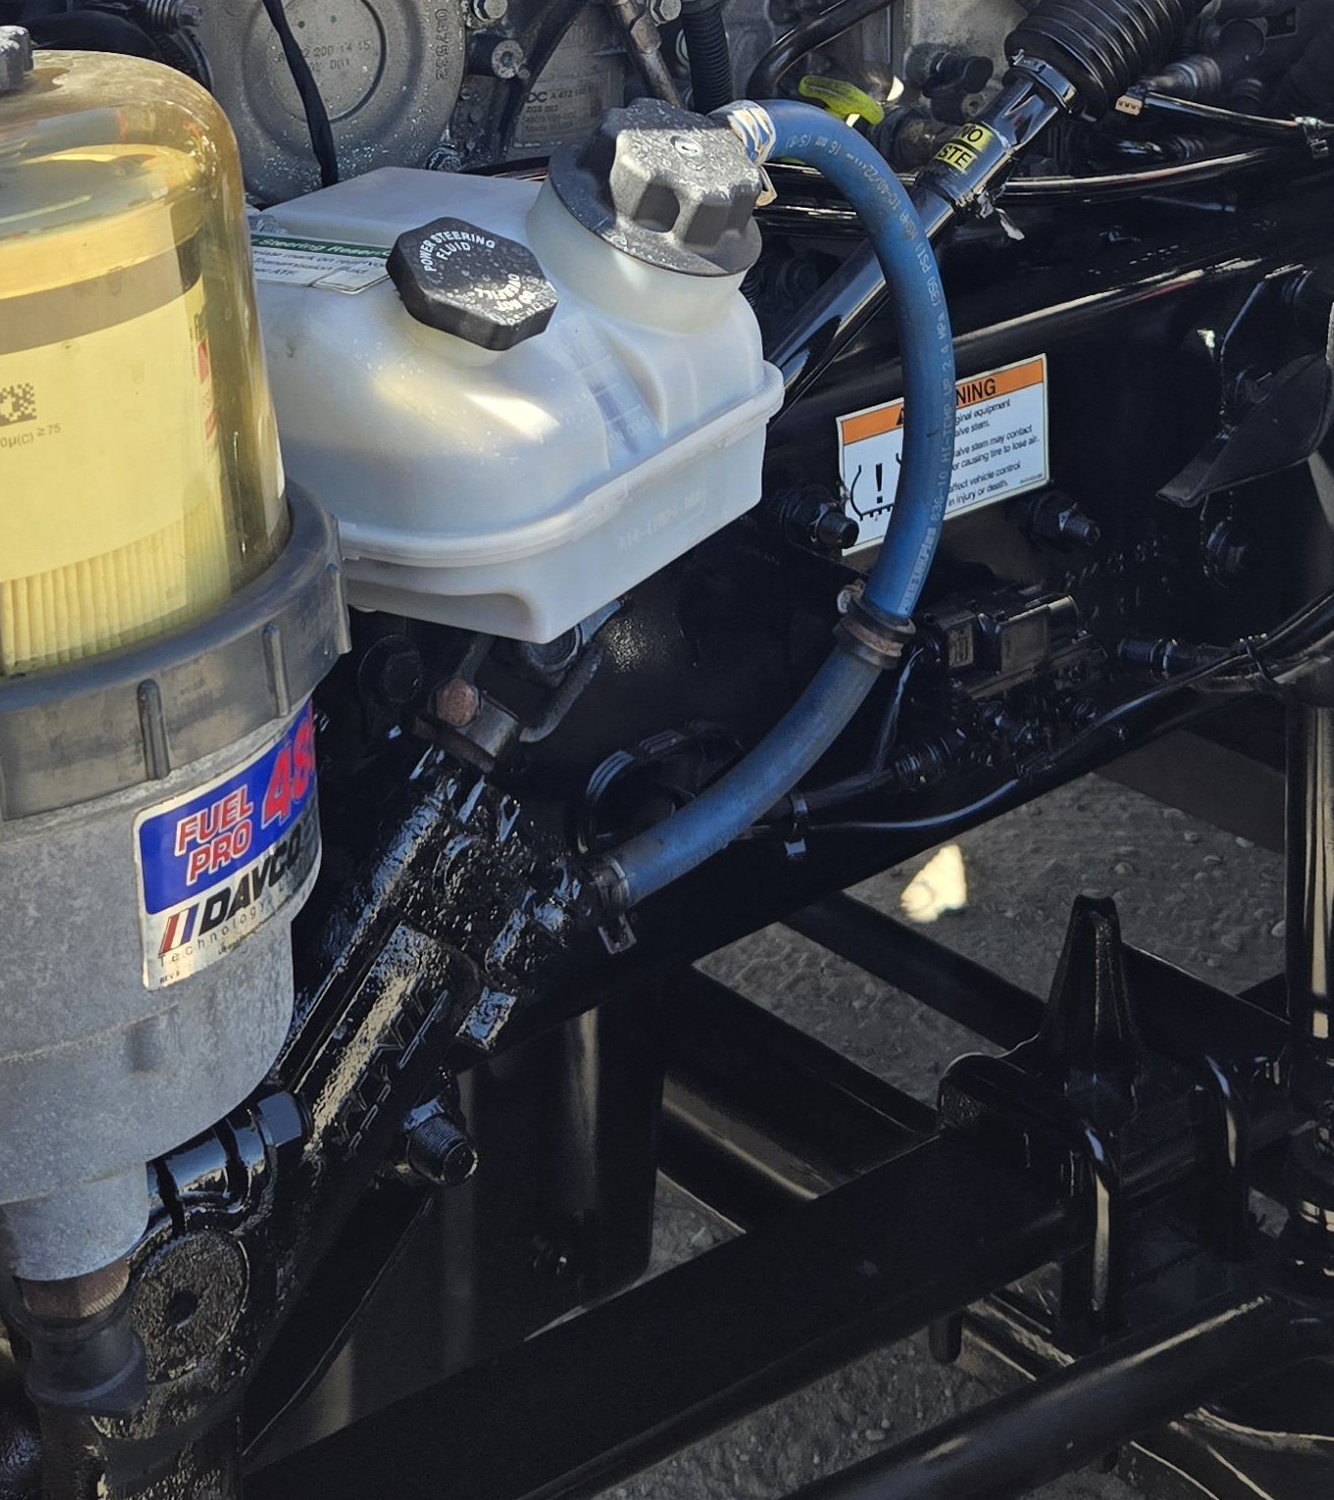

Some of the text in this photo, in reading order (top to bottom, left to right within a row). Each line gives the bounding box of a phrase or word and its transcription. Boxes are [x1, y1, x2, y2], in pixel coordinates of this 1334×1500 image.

[830, 140, 842, 156] 16
[937, 145, 973, 169] STE
[259, 238, 327, 252] Steering
[419, 230, 496, 273] POWER STEERING
[436, 242, 472, 261] FLUID
[915, 241, 933, 274] PSI)
[927, 275, 942, 308] (350
[956, 378, 996, 406] NING
[956, 398, 1011, 425] ginal equipment
[941, 403, 956, 463] HI-TEMP
[955, 420, 990, 438] alve stem.
[955, 424, 1033, 457] alve stem may contact
[961, 452, 989, 468] causing
[990, 448, 1002, 458] tire
[1003, 445, 1011, 453] to
[1012, 439, 1027, 450] lose
[1028, 434, 1040, 446] air.
[970, 469, 995, 486] vehicle
[995, 460, 1021, 477] control
[930, 470, 948, 522] 836-10
[948, 479, 1009, 507] in injury or death.
[261, 710, 315, 829] 48
[175, 784, 254, 856] FUEL
[186, 820, 252, 887] PRO
[199, 825, 301, 937] DAVCO
